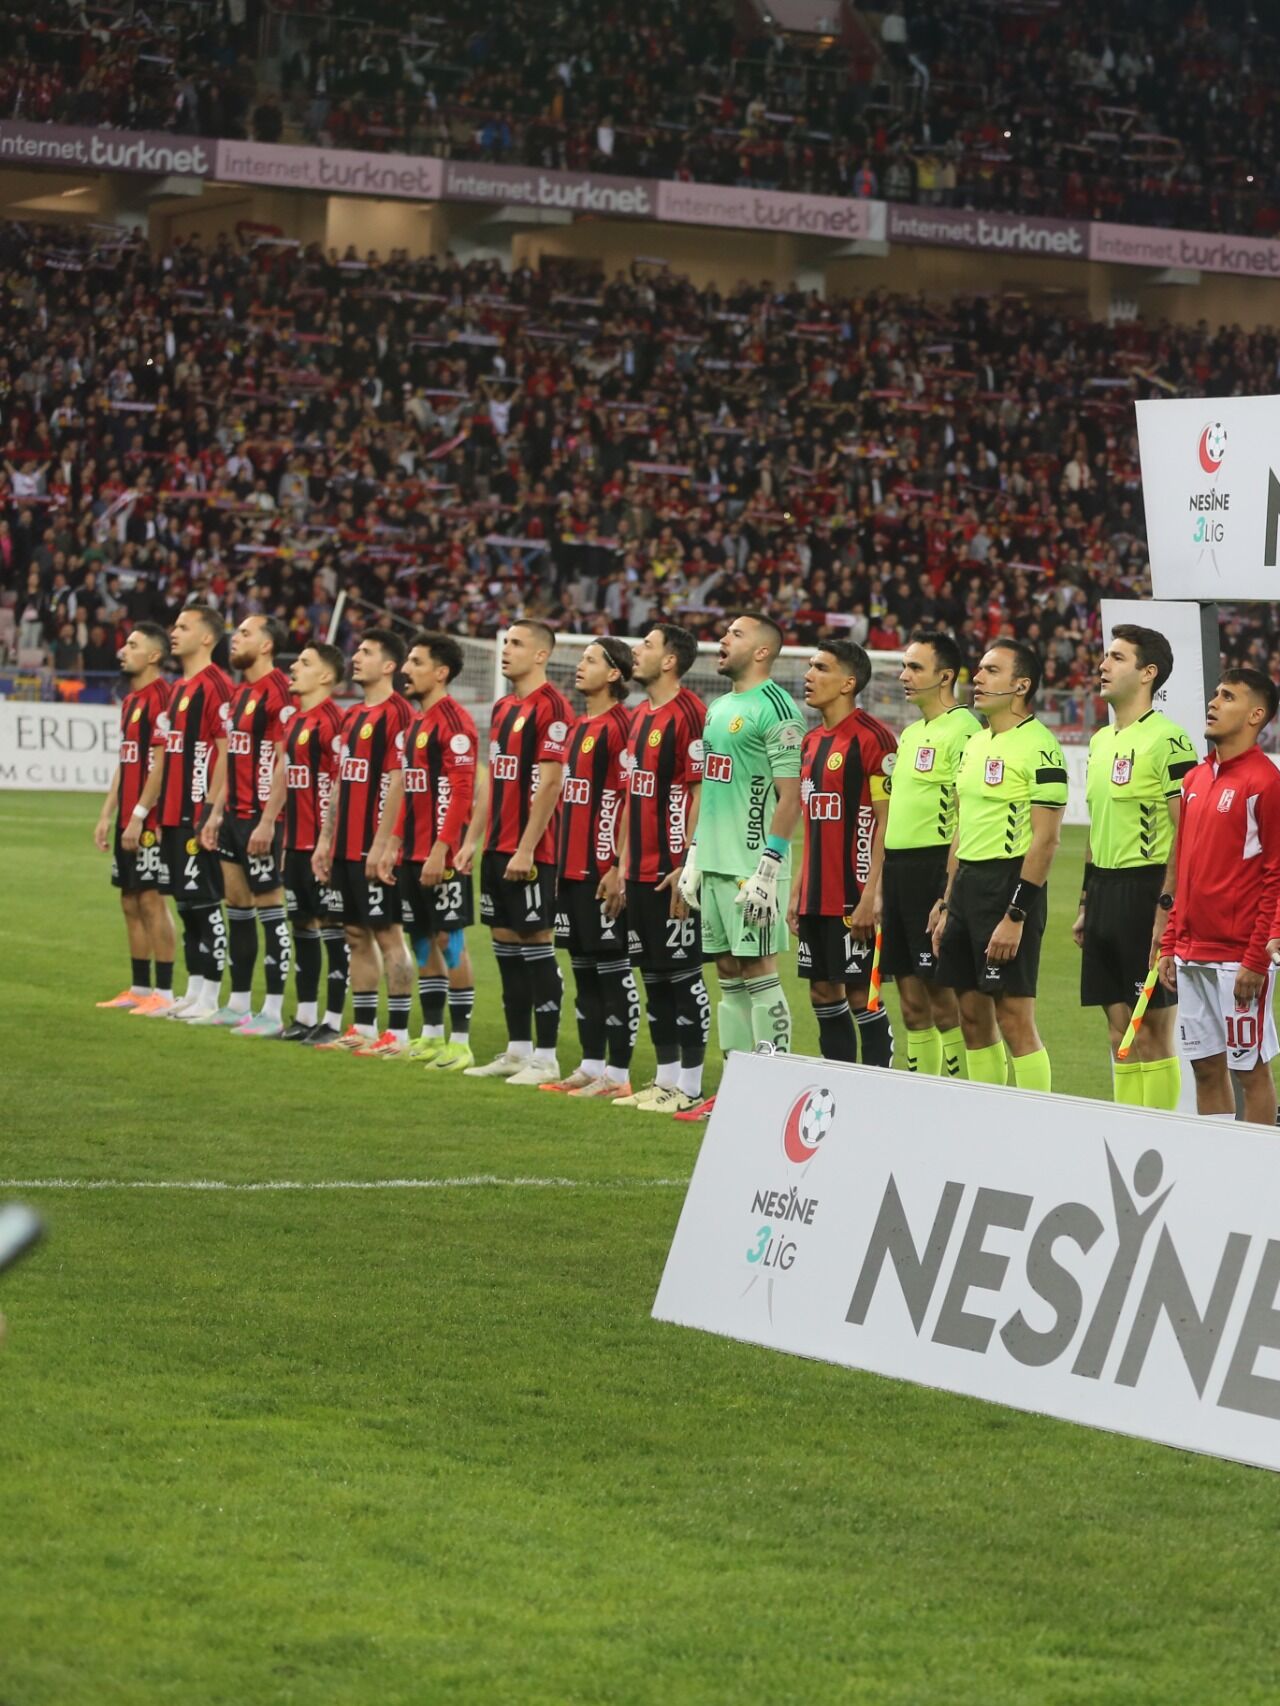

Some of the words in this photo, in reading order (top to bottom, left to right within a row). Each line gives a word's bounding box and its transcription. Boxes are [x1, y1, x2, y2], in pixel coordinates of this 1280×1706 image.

[0, 135, 88, 164] nternet,
[91, 136, 209, 174] turknet
[318, 155, 432, 193] turknet
[538, 176, 651, 213] turknet
[753, 196, 860, 233] turknet
[977, 218, 1083, 254] turknet
[1038, 750, 1062, 767] NG
[1167, 734, 1193, 755] NG
[191, 741, 208, 803] EUROPEN
[258, 740, 273, 801] EUROPEN
[596, 788, 617, 861] EUROPEN
[669, 784, 683, 854] EUROPEN
[747, 775, 766, 851] EUROPEN
[136, 847, 160, 873] 96
[856, 805, 873, 884] EUROPEN
[184, 855, 200, 879] 4
[368, 882, 384, 905] 5
[434, 882, 463, 911] 33
[524, 883, 542, 910] 11
[666, 918, 696, 947] 26
[843, 932, 871, 961] 14
[1225, 1016, 1257, 1048] 10
